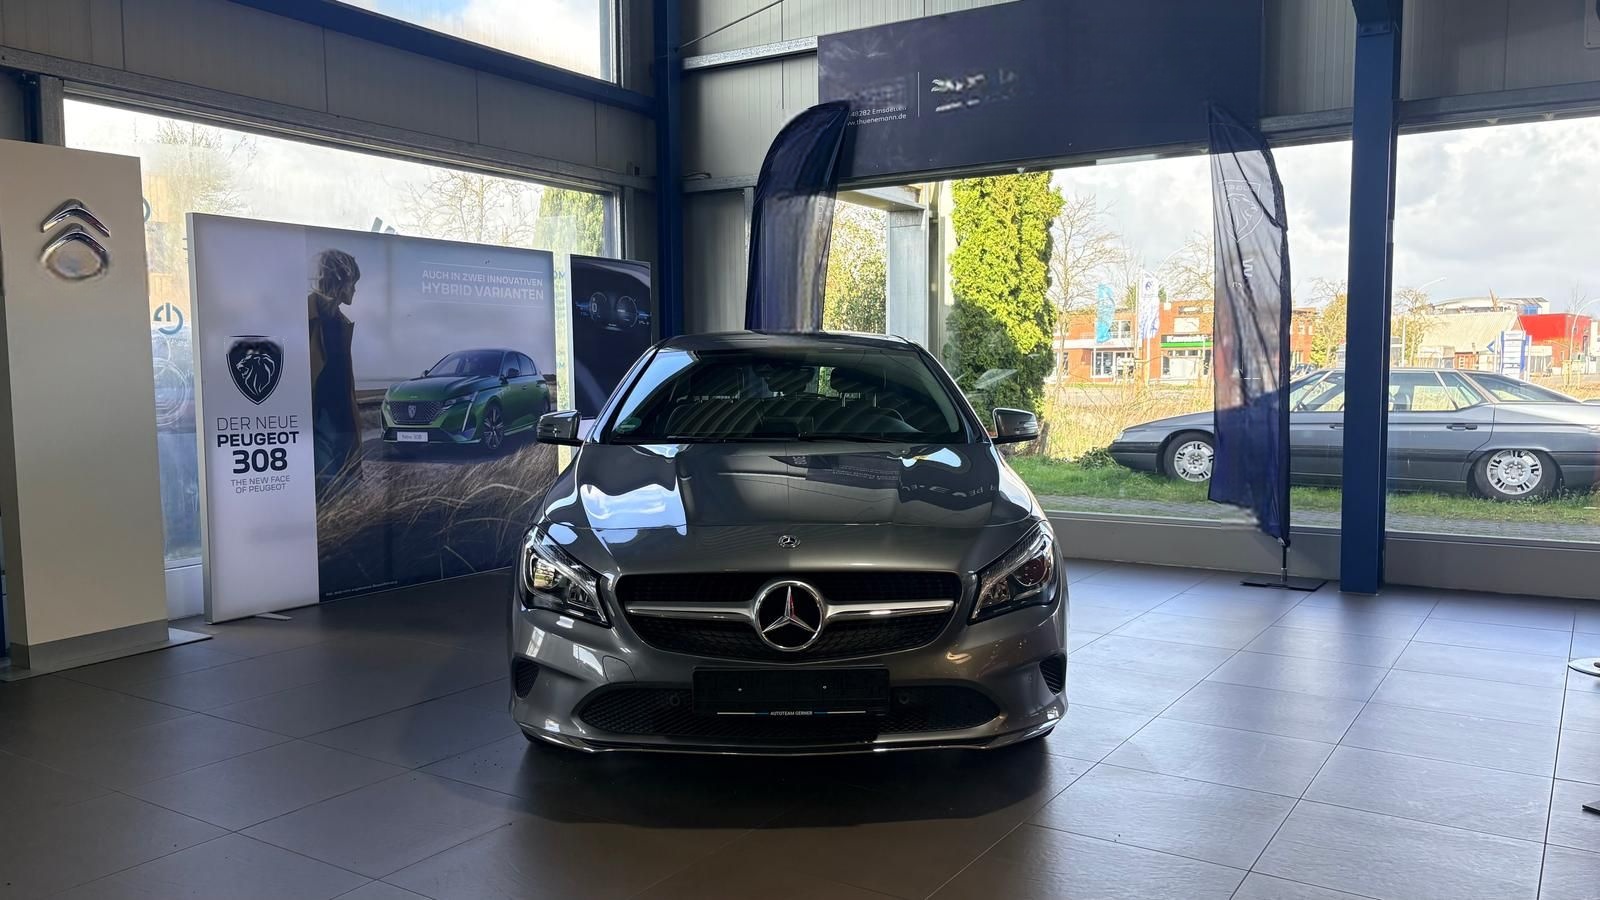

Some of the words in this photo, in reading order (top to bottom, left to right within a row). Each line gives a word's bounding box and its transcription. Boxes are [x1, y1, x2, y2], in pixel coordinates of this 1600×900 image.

[422, 270, 449, 280] AUCH
[451, 272, 460, 281] IN
[462, 273, 484, 282] ZWEI
[487, 274, 543, 287] INNOVATIVEN
[422, 282, 472, 296] HYBRID
[475, 285, 544, 300] VARIANTEN
[217, 416, 251, 431] DER
[256, 415, 299, 430] NEUE
[217, 431, 299, 448] PEUGEOT
[232, 447, 288, 474] 308
[230, 478, 248, 487] THE
[249, 476, 269, 485] NEW
[270, 475, 291, 483] FACE
[235, 486, 247, 494] OF
[249, 483, 287, 493] PEUGEOT
